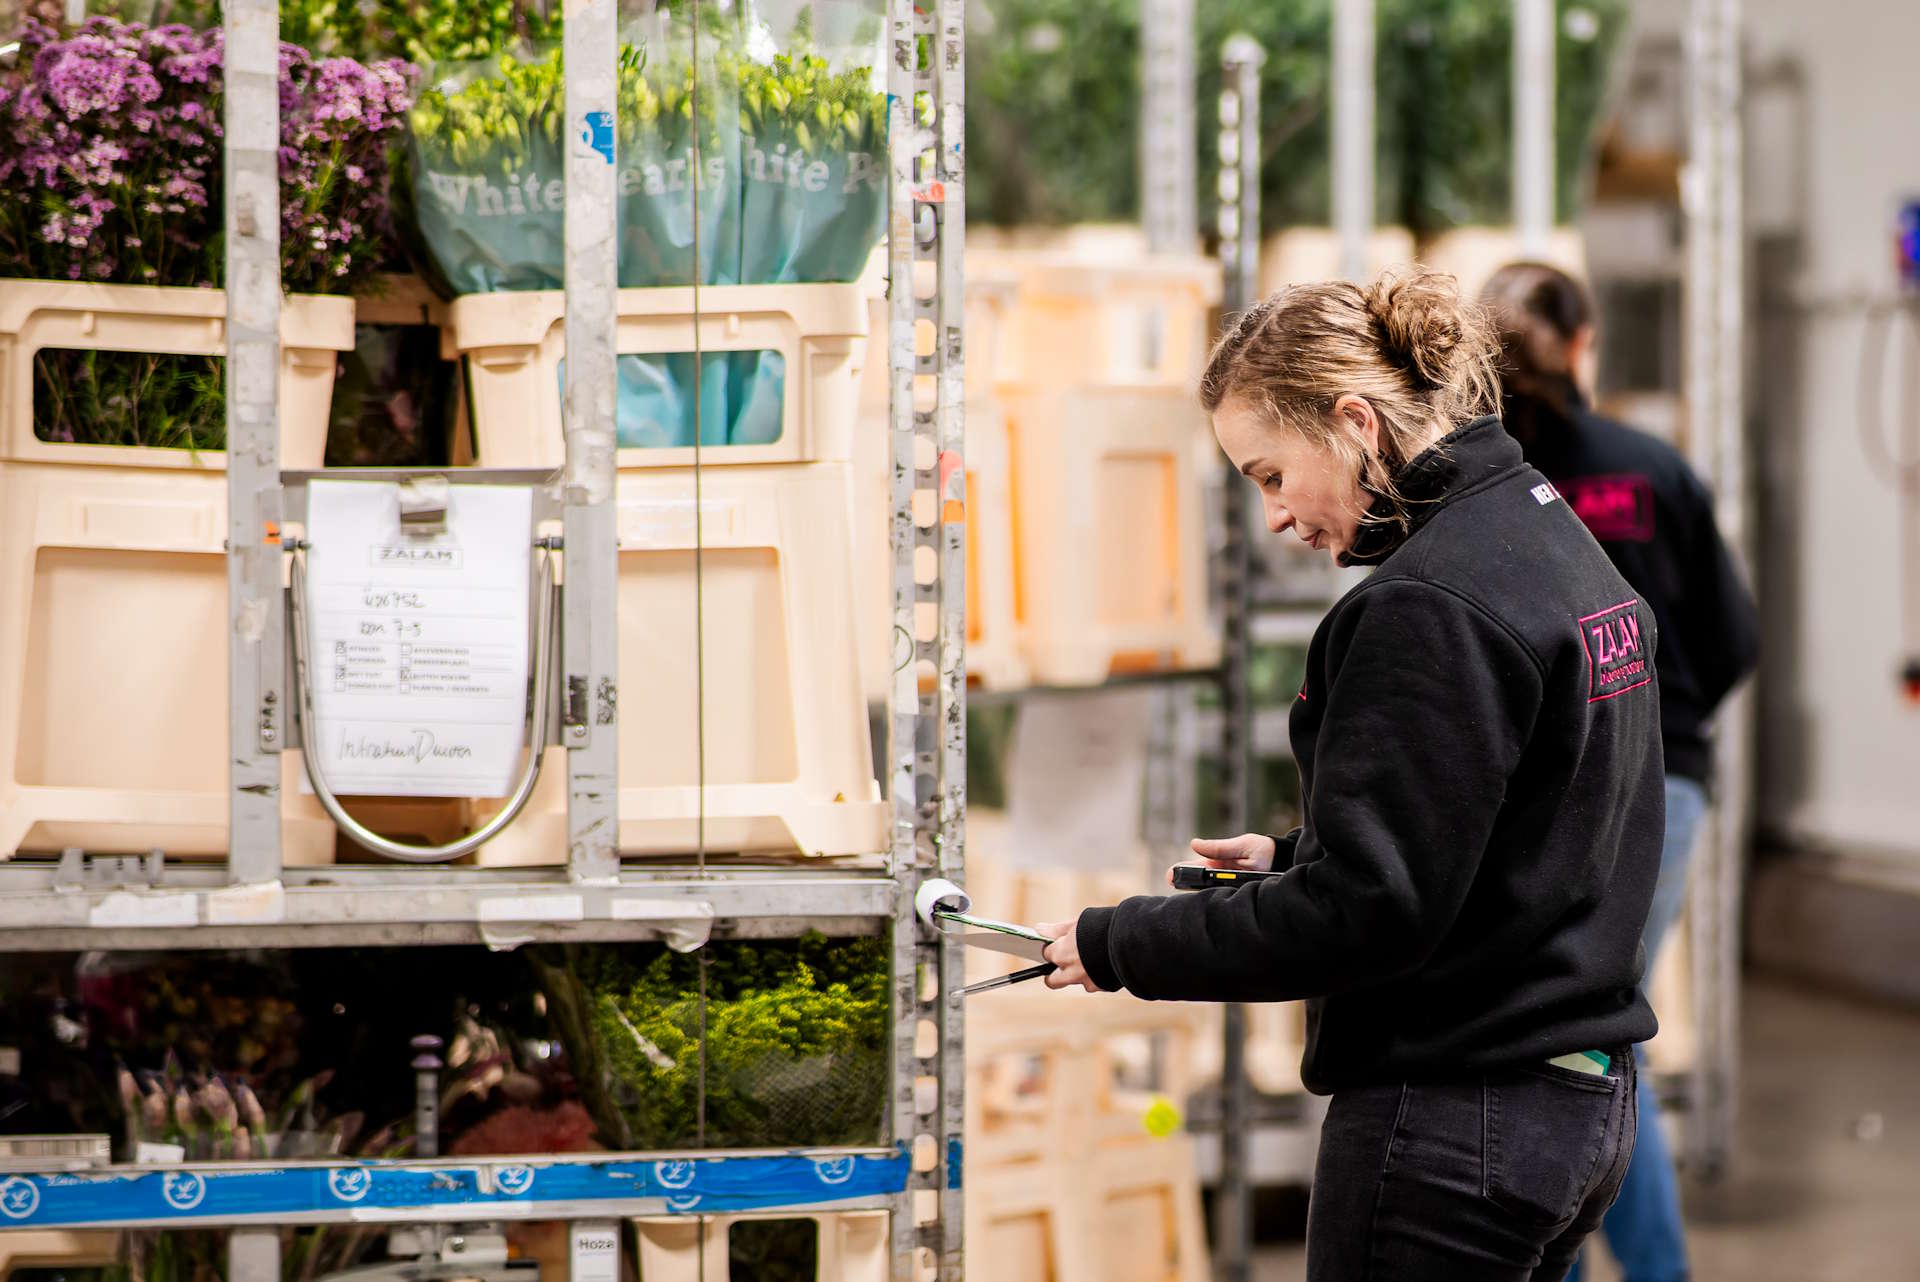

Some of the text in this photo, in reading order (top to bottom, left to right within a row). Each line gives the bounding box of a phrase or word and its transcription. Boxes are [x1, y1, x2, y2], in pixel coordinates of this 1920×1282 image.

[617, 146, 726, 197] earls
[743, 134, 829, 192] hite
[380, 547, 453, 561] ZALAM
[1592, 611, 1640, 665] ZALAM
